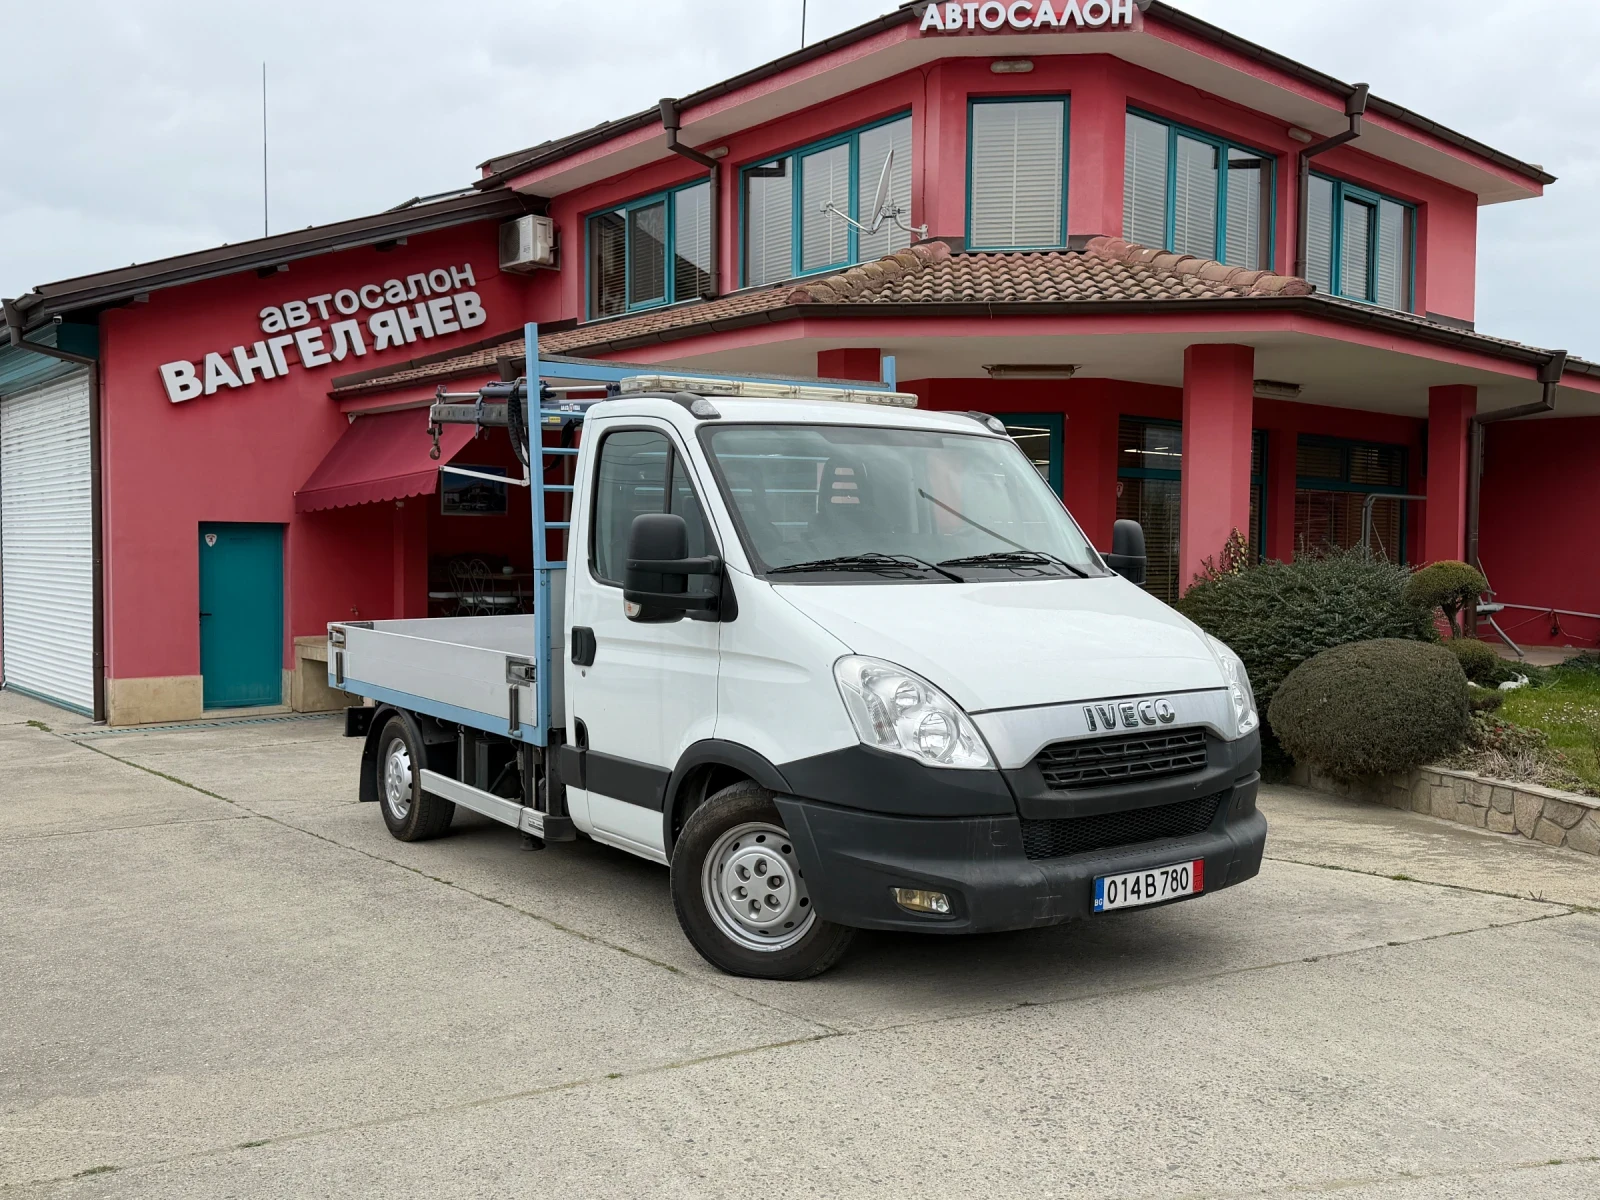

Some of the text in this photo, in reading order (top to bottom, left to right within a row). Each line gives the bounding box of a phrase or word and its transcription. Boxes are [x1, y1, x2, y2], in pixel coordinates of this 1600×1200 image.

[919, 0, 1132, 32] АВТОСАЛОН
[259, 263, 476, 334] автосалон
[1083, 699, 1175, 731] IVECO
[1094, 898, 1103, 907] BG
[1107, 867, 1189, 904] 014B780
